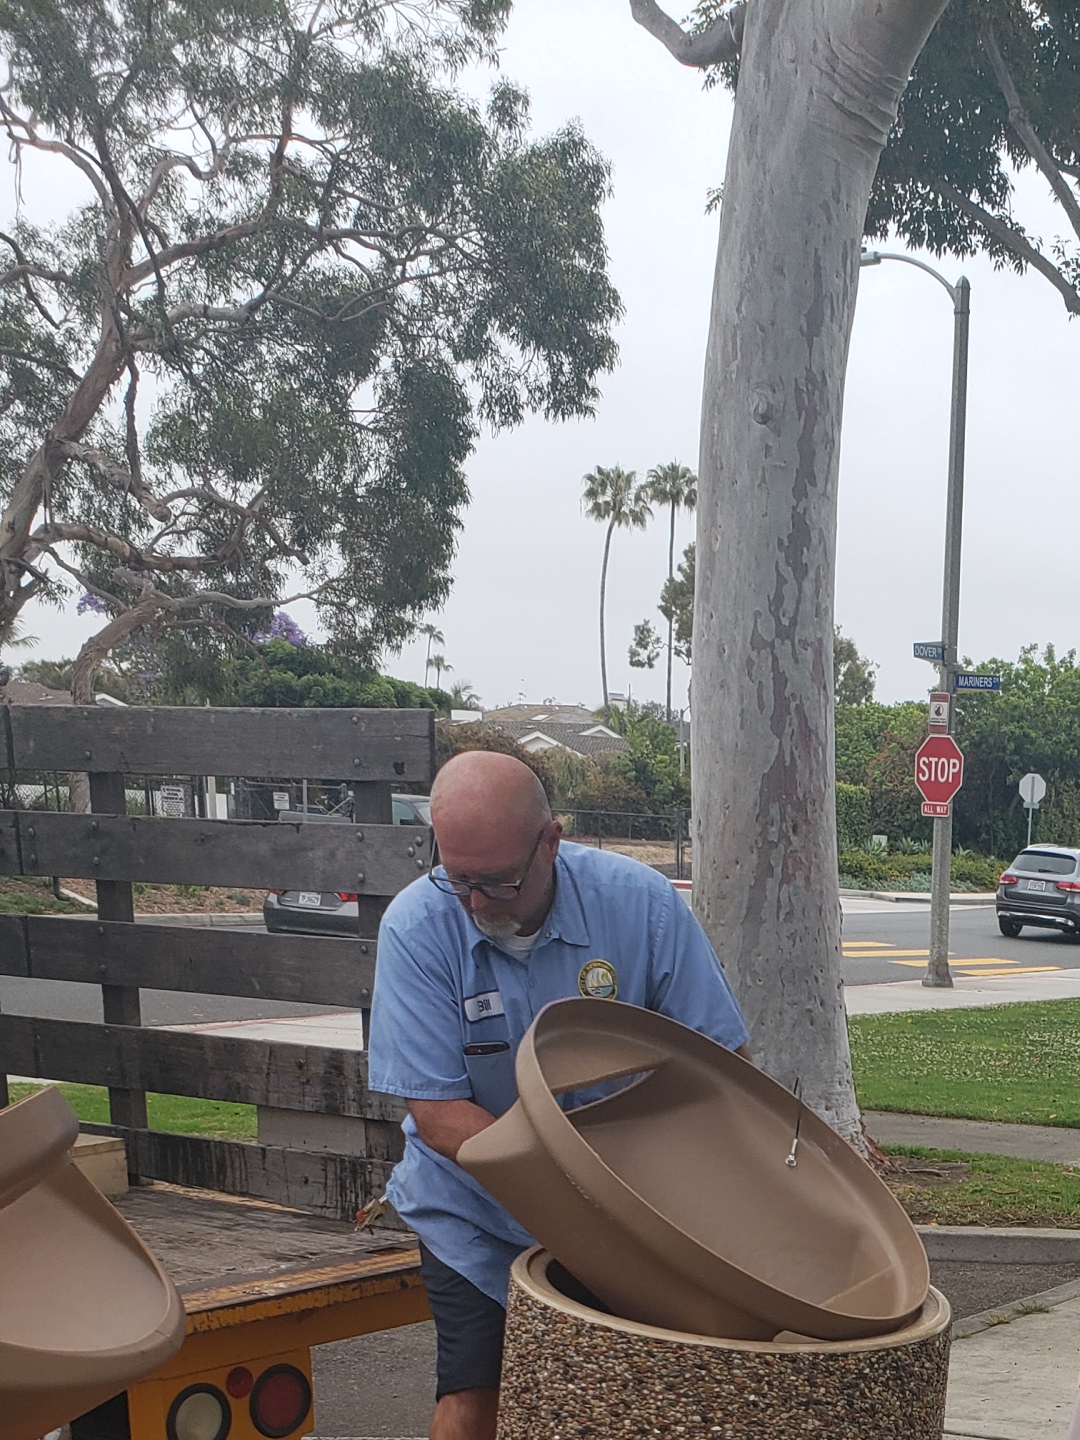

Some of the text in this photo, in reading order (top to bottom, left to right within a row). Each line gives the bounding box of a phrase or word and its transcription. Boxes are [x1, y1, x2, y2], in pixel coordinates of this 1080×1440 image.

[915, 645, 937, 658] DOVER
[958, 676, 993, 688] MARINERS
[919, 757, 960, 783] STOP
[924, 805, 948, 814] ALL WAY
